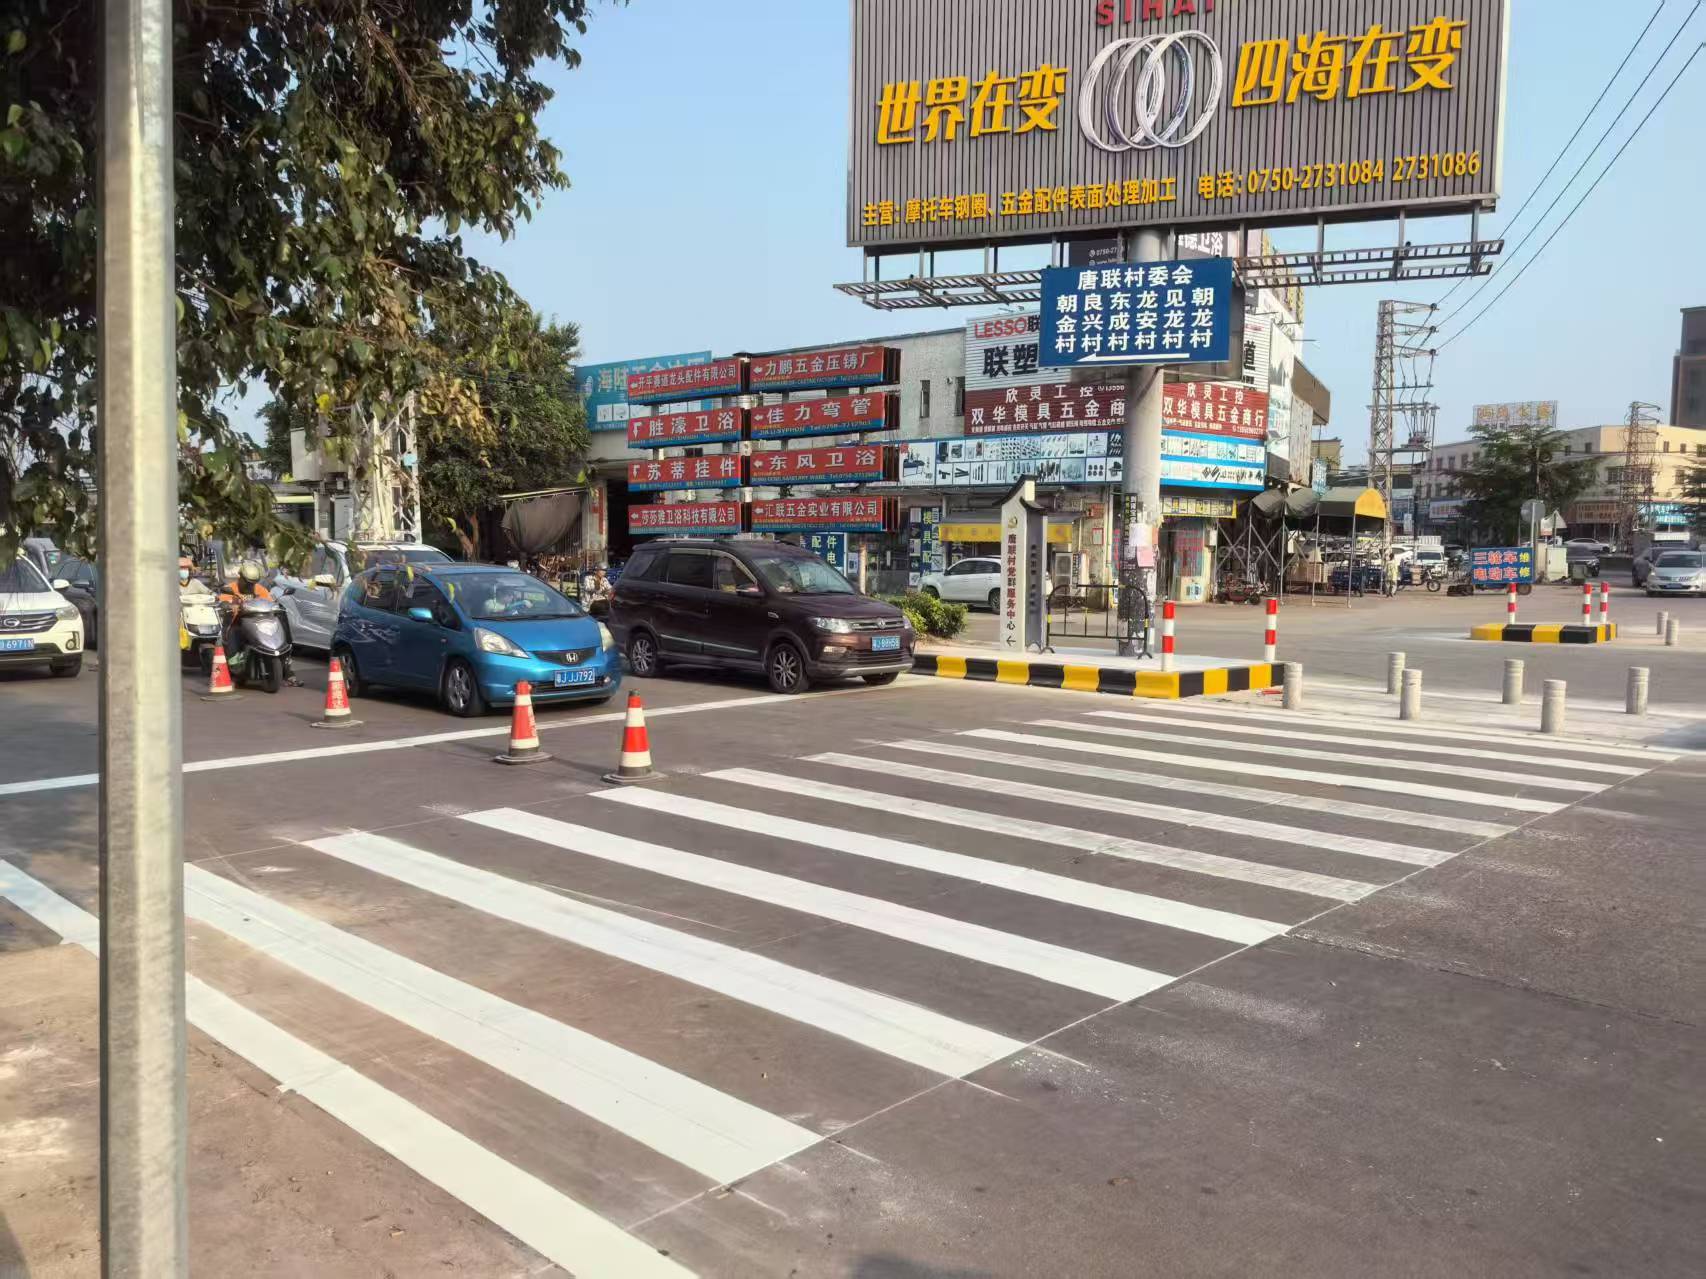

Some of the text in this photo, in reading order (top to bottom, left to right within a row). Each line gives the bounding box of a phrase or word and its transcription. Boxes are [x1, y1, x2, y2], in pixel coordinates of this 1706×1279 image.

[1232, 16, 1468, 108] 四海在变
[877, 64, 1068, 145] 世界在变
[1392, 151, 1480, 182] 2731086
[1077, 264, 1193, 290] 唐联村委会
[975, 318, 1027, 339] LESSO
[1006, 384, 1094, 404] 欣灵工控
[1187, 382, 1243, 405] 欣灵工控
[767, 398, 871, 424] 佳力弯管
[971, 398, 1125, 425] 双华模具五金商
[1163, 396, 1264, 427] 双华模具五金商行
[648, 457, 736, 480] 苏蒂挂件
[769, 449, 876, 470] 东风卫浴
[765, 501, 877, 518] 汇联五金实业有限公司
